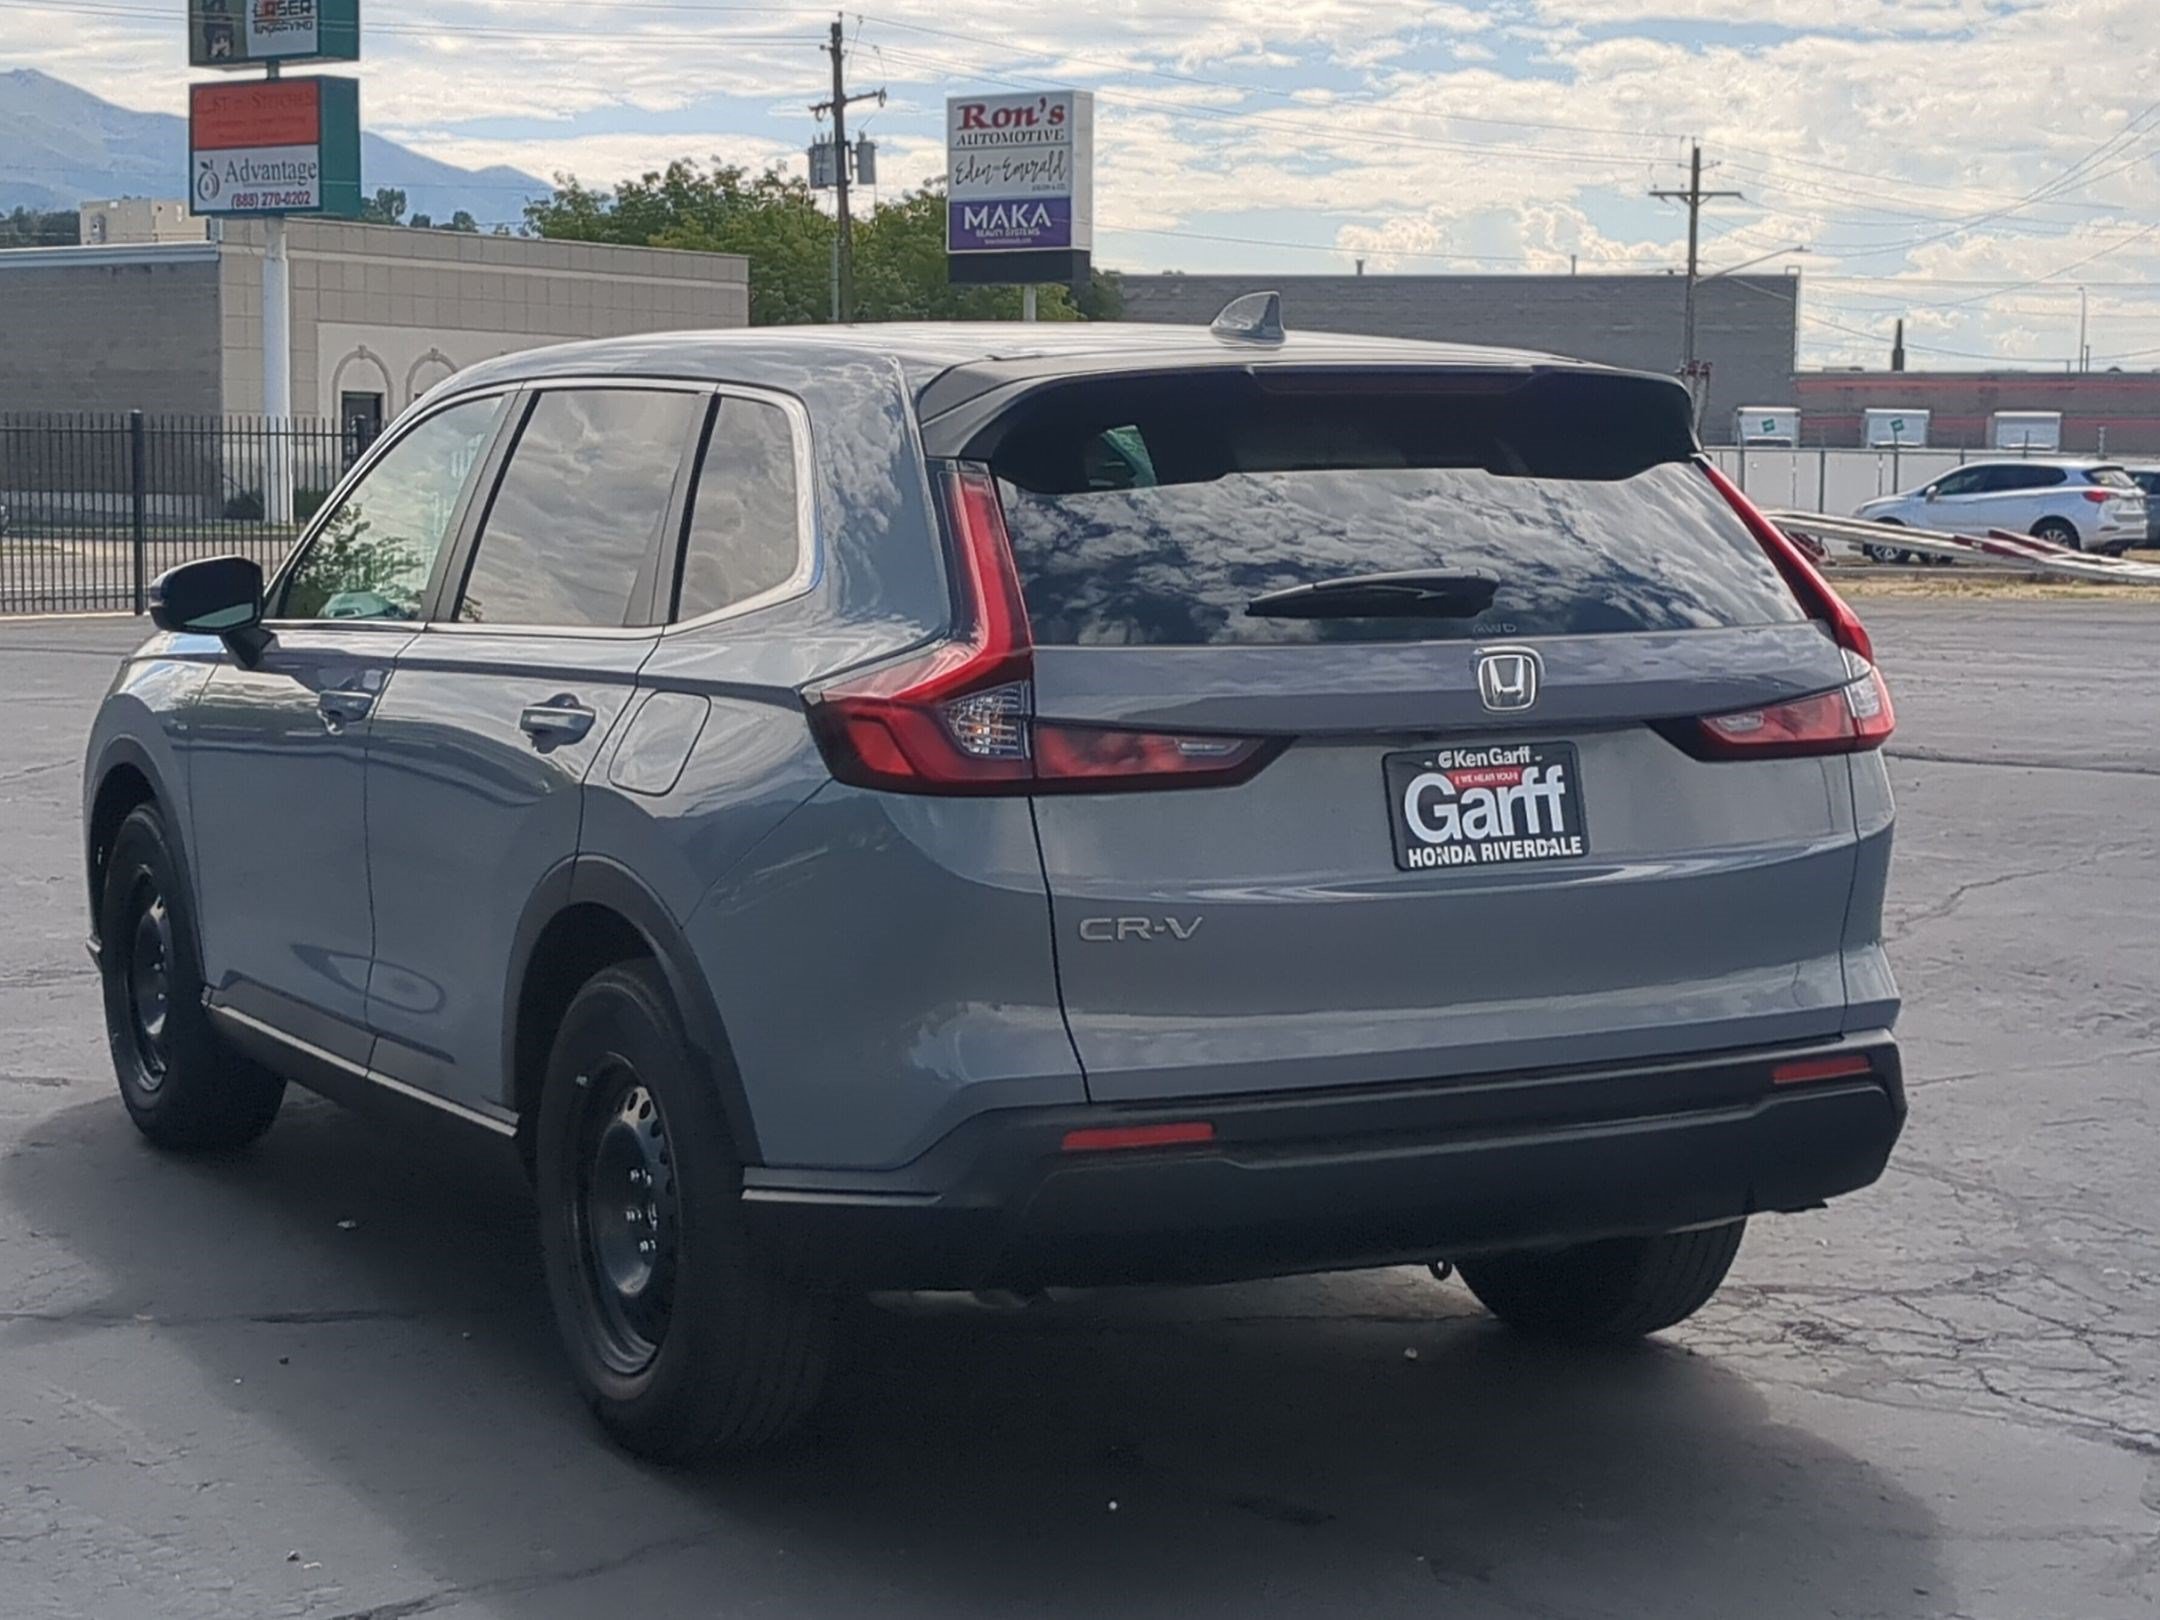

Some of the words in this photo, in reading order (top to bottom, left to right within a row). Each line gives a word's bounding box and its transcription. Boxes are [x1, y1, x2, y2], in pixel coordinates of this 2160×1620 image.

[956, 97, 1066, 131] Ron's
[956, 128, 1065, 147] AUTOMOTIVE
[225, 157, 318, 187] Advantage
[964, 203, 1052, 231] MAKA
[1404, 764, 1566, 844] Garff
[1408, 845, 1477, 868] HONDA
[1481, 836, 1583, 862] RIVERDALE
[1080, 916, 1203, 941] CR-V
